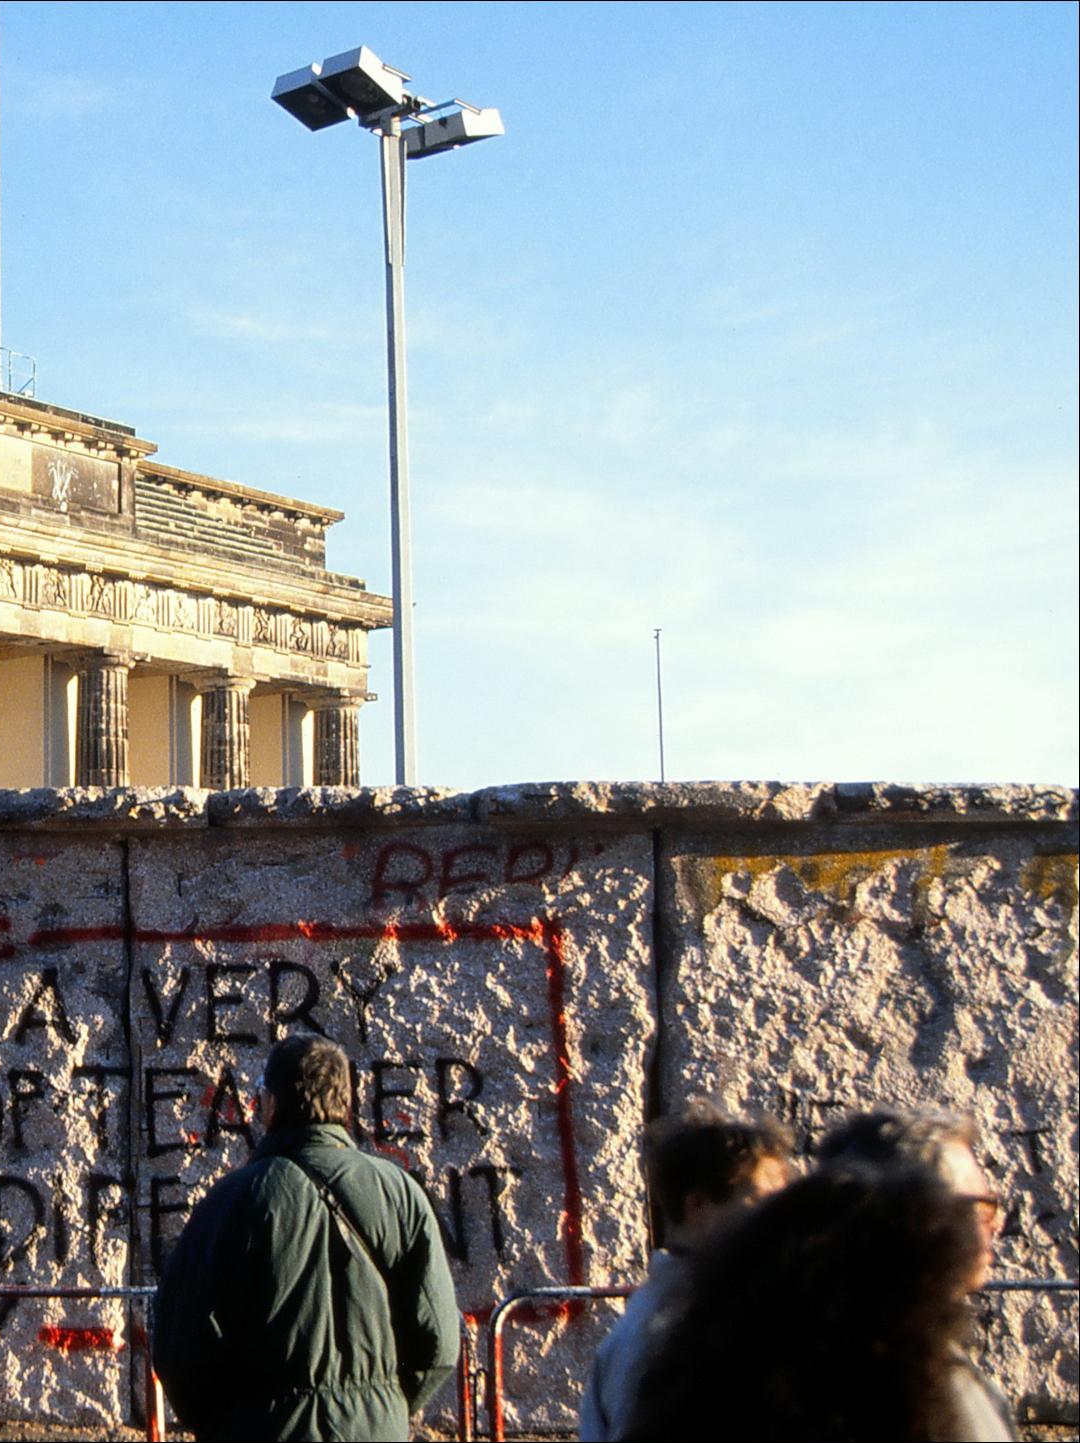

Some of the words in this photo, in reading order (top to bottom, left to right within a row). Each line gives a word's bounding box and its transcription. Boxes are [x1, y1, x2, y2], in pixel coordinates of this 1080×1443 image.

[13, 967, 77, 1046] A
[142, 960, 393, 1049] VERY
[72, 1057, 489, 1158] TEAER
